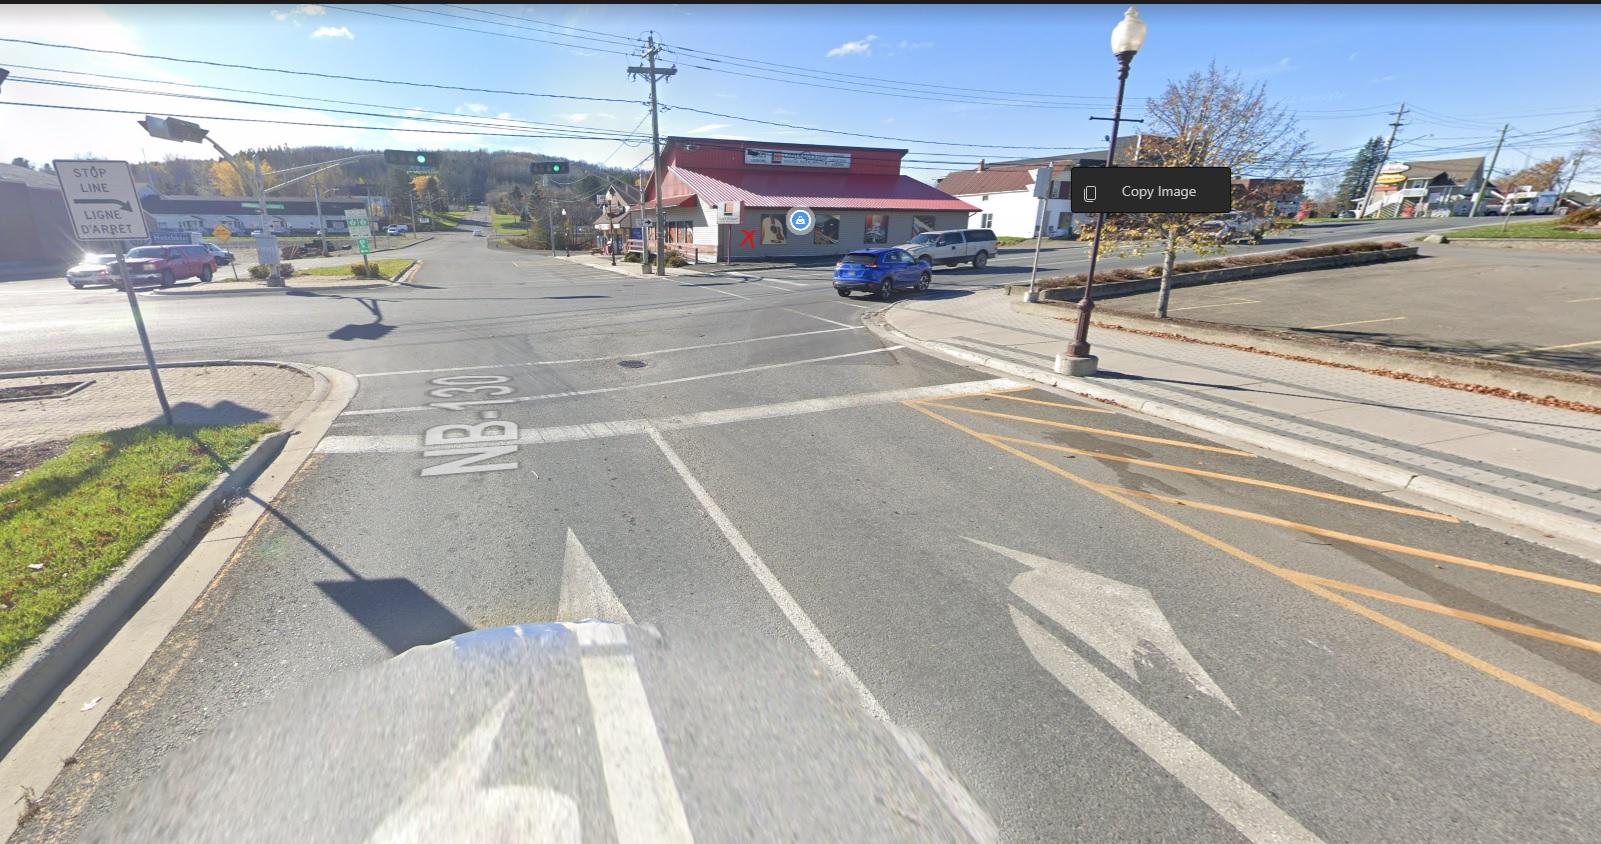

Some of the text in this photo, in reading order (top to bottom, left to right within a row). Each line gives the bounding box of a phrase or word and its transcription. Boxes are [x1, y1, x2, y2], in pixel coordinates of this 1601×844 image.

[73, 167, 107, 179] STOP
[80, 183, 110, 193] LINE
[83, 210, 123, 220] LIGNE
[80, 224, 133, 235] D'ARRET
